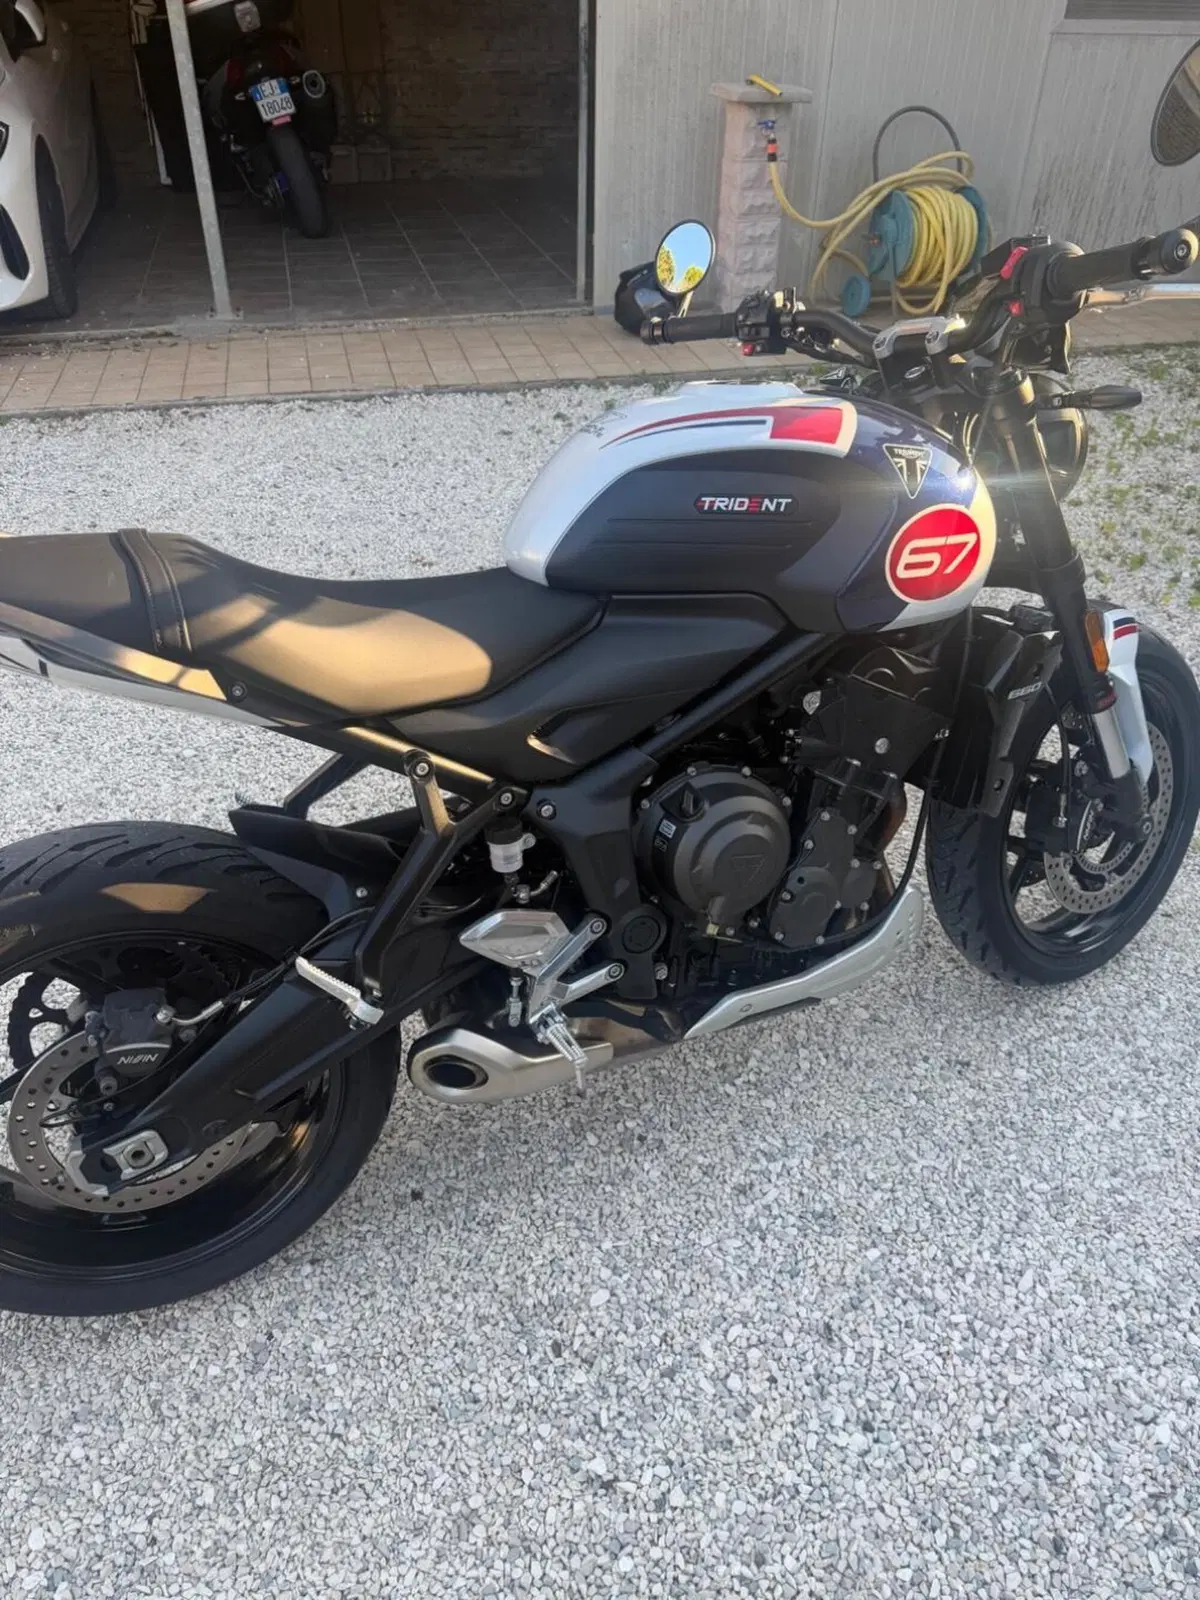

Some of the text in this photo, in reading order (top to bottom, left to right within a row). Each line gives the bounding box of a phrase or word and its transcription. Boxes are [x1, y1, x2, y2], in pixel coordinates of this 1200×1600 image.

[260, 82, 276, 98] EJ
[261, 96, 293, 116] 18048
[700, 497, 793, 512] TRIDENT
[896, 532, 978, 579] 67
